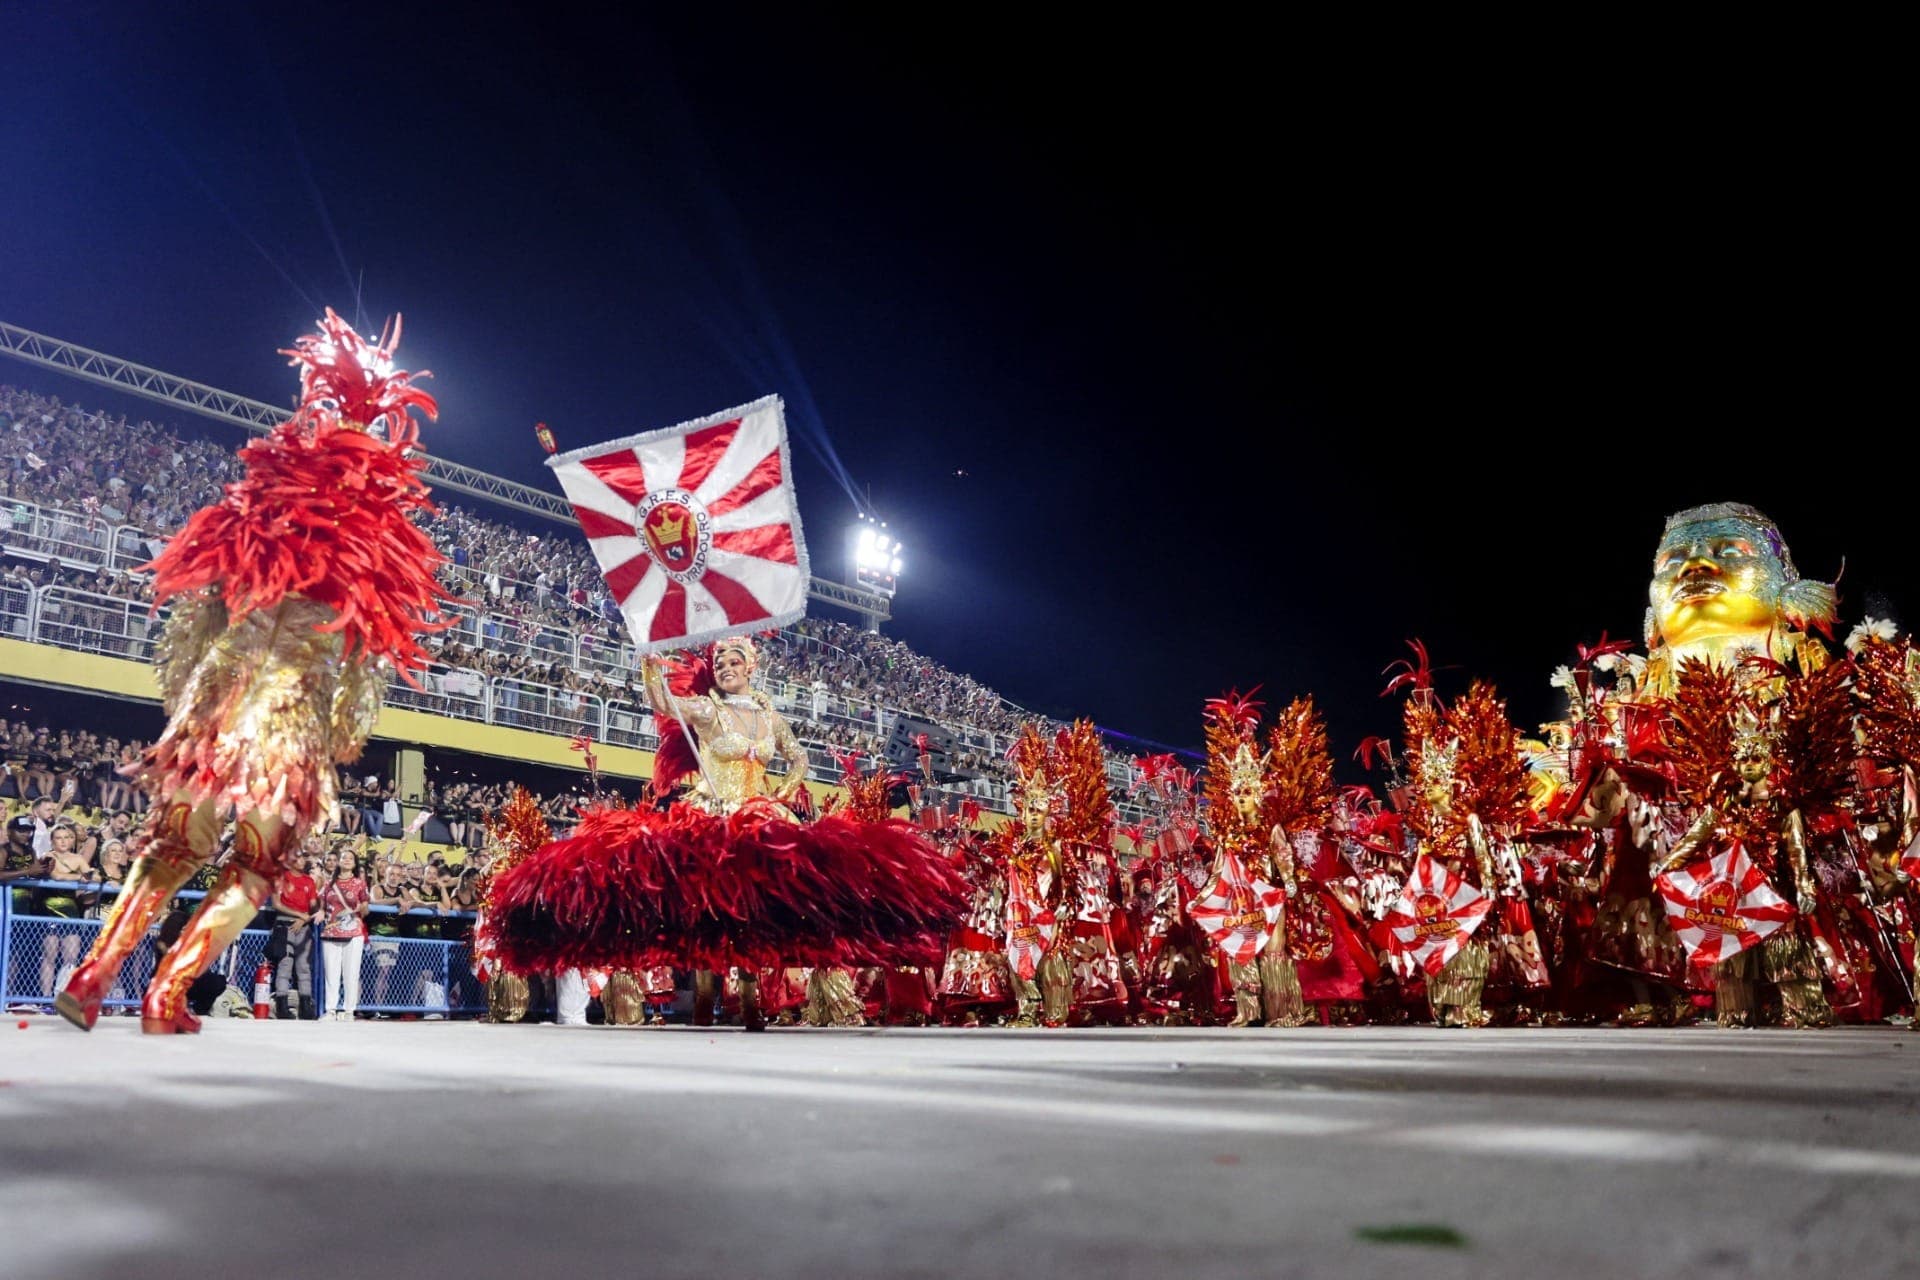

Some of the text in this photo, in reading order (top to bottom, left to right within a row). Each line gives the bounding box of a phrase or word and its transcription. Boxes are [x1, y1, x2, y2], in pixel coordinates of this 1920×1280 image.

[639, 490, 692, 518] G.R.E.S.
[684, 512, 711, 582] VIRADOURO
[1685, 908, 1747, 930] BATERIA
